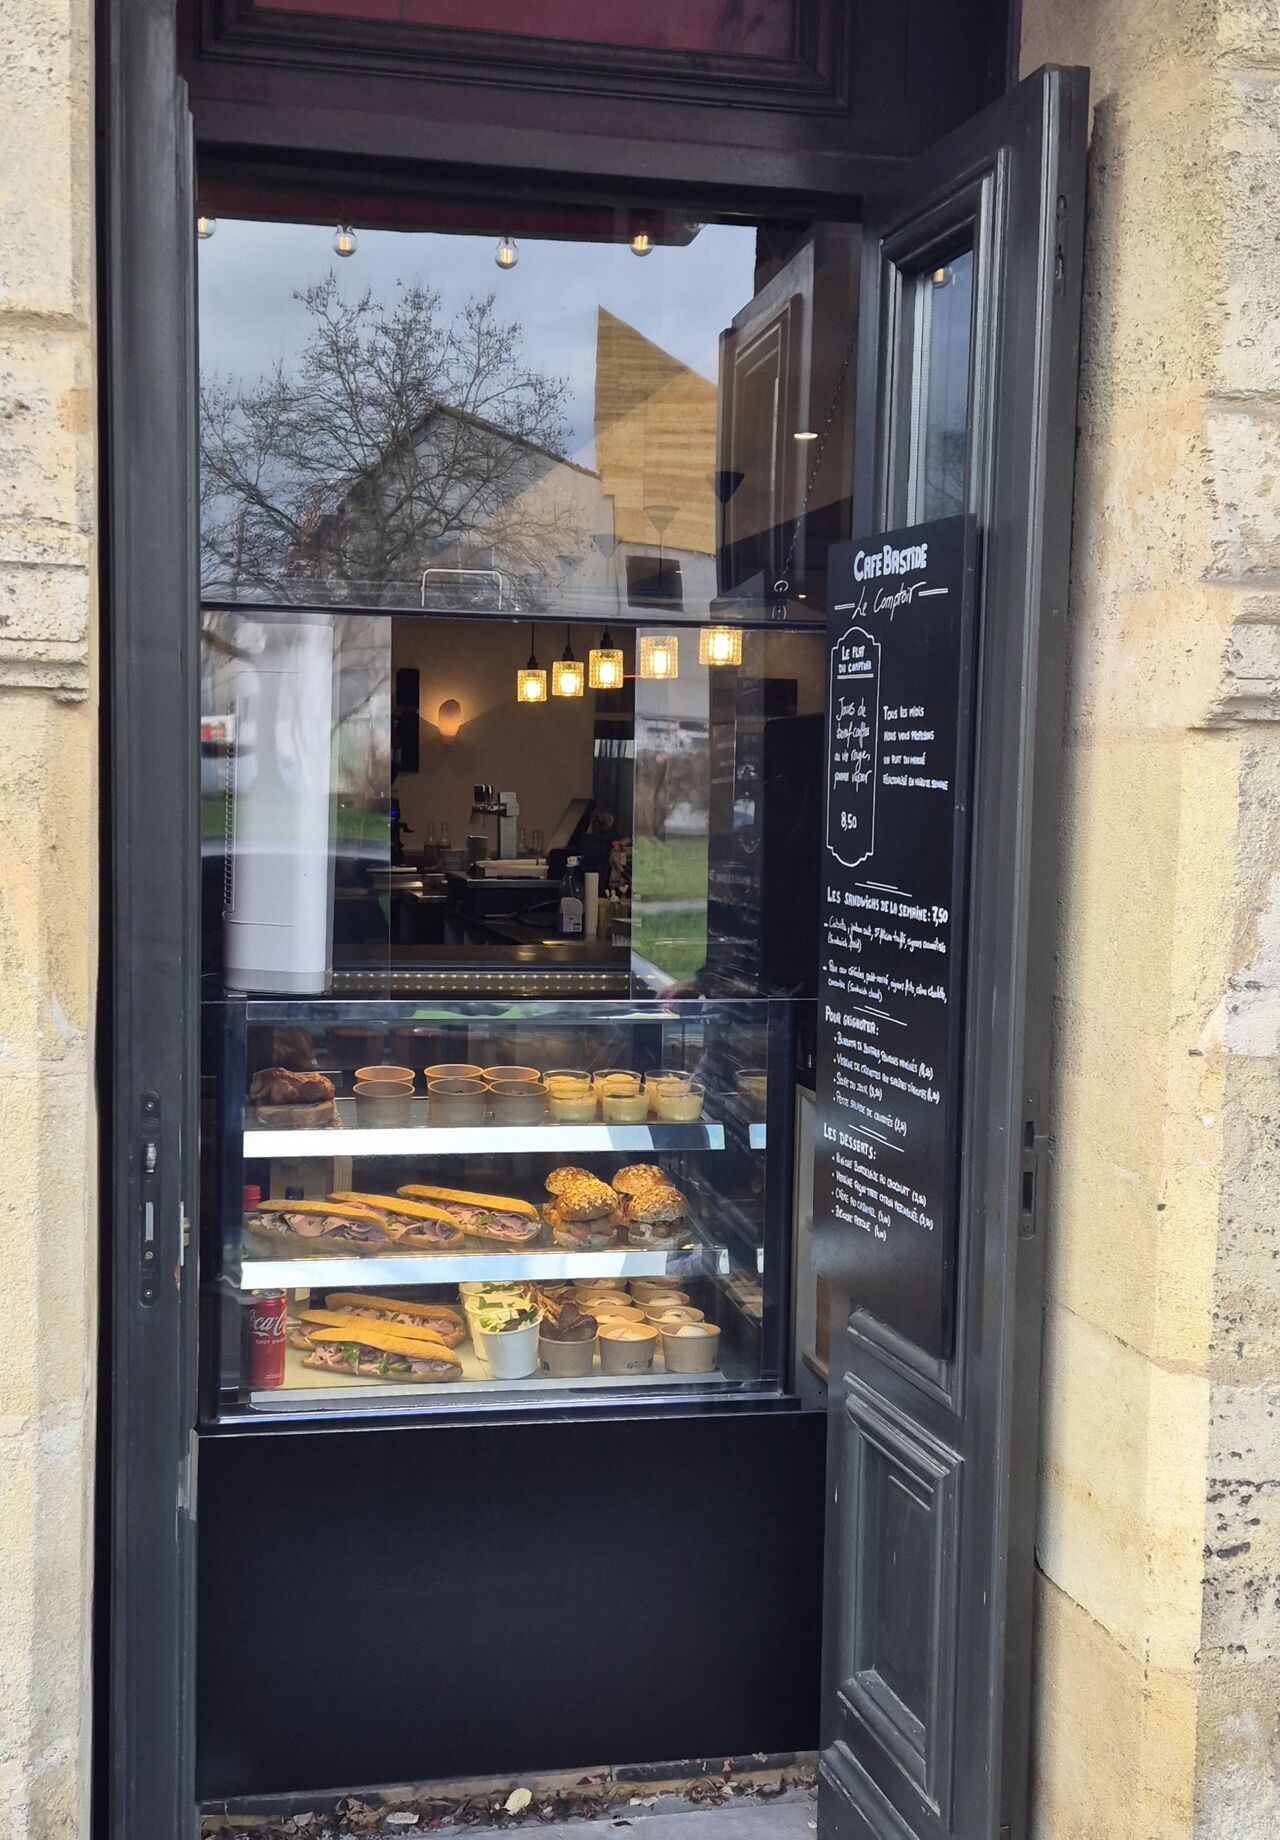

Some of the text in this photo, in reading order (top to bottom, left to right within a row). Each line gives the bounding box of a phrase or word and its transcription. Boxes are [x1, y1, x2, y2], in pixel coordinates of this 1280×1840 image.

[883, 543, 928, 576] BASTIDE
[852, 581, 927, 622] Le Comptoir
[841, 645, 865, 661] LE PLAT
[838, 660, 872, 674] DU COMPTOIR
[841, 811, 857, 831] 8,50
[827, 886, 841, 904] LES
[880, 900, 889, 913] DE
[889, 901, 897, 915] LA
[823, 1122, 837, 1142] LES
